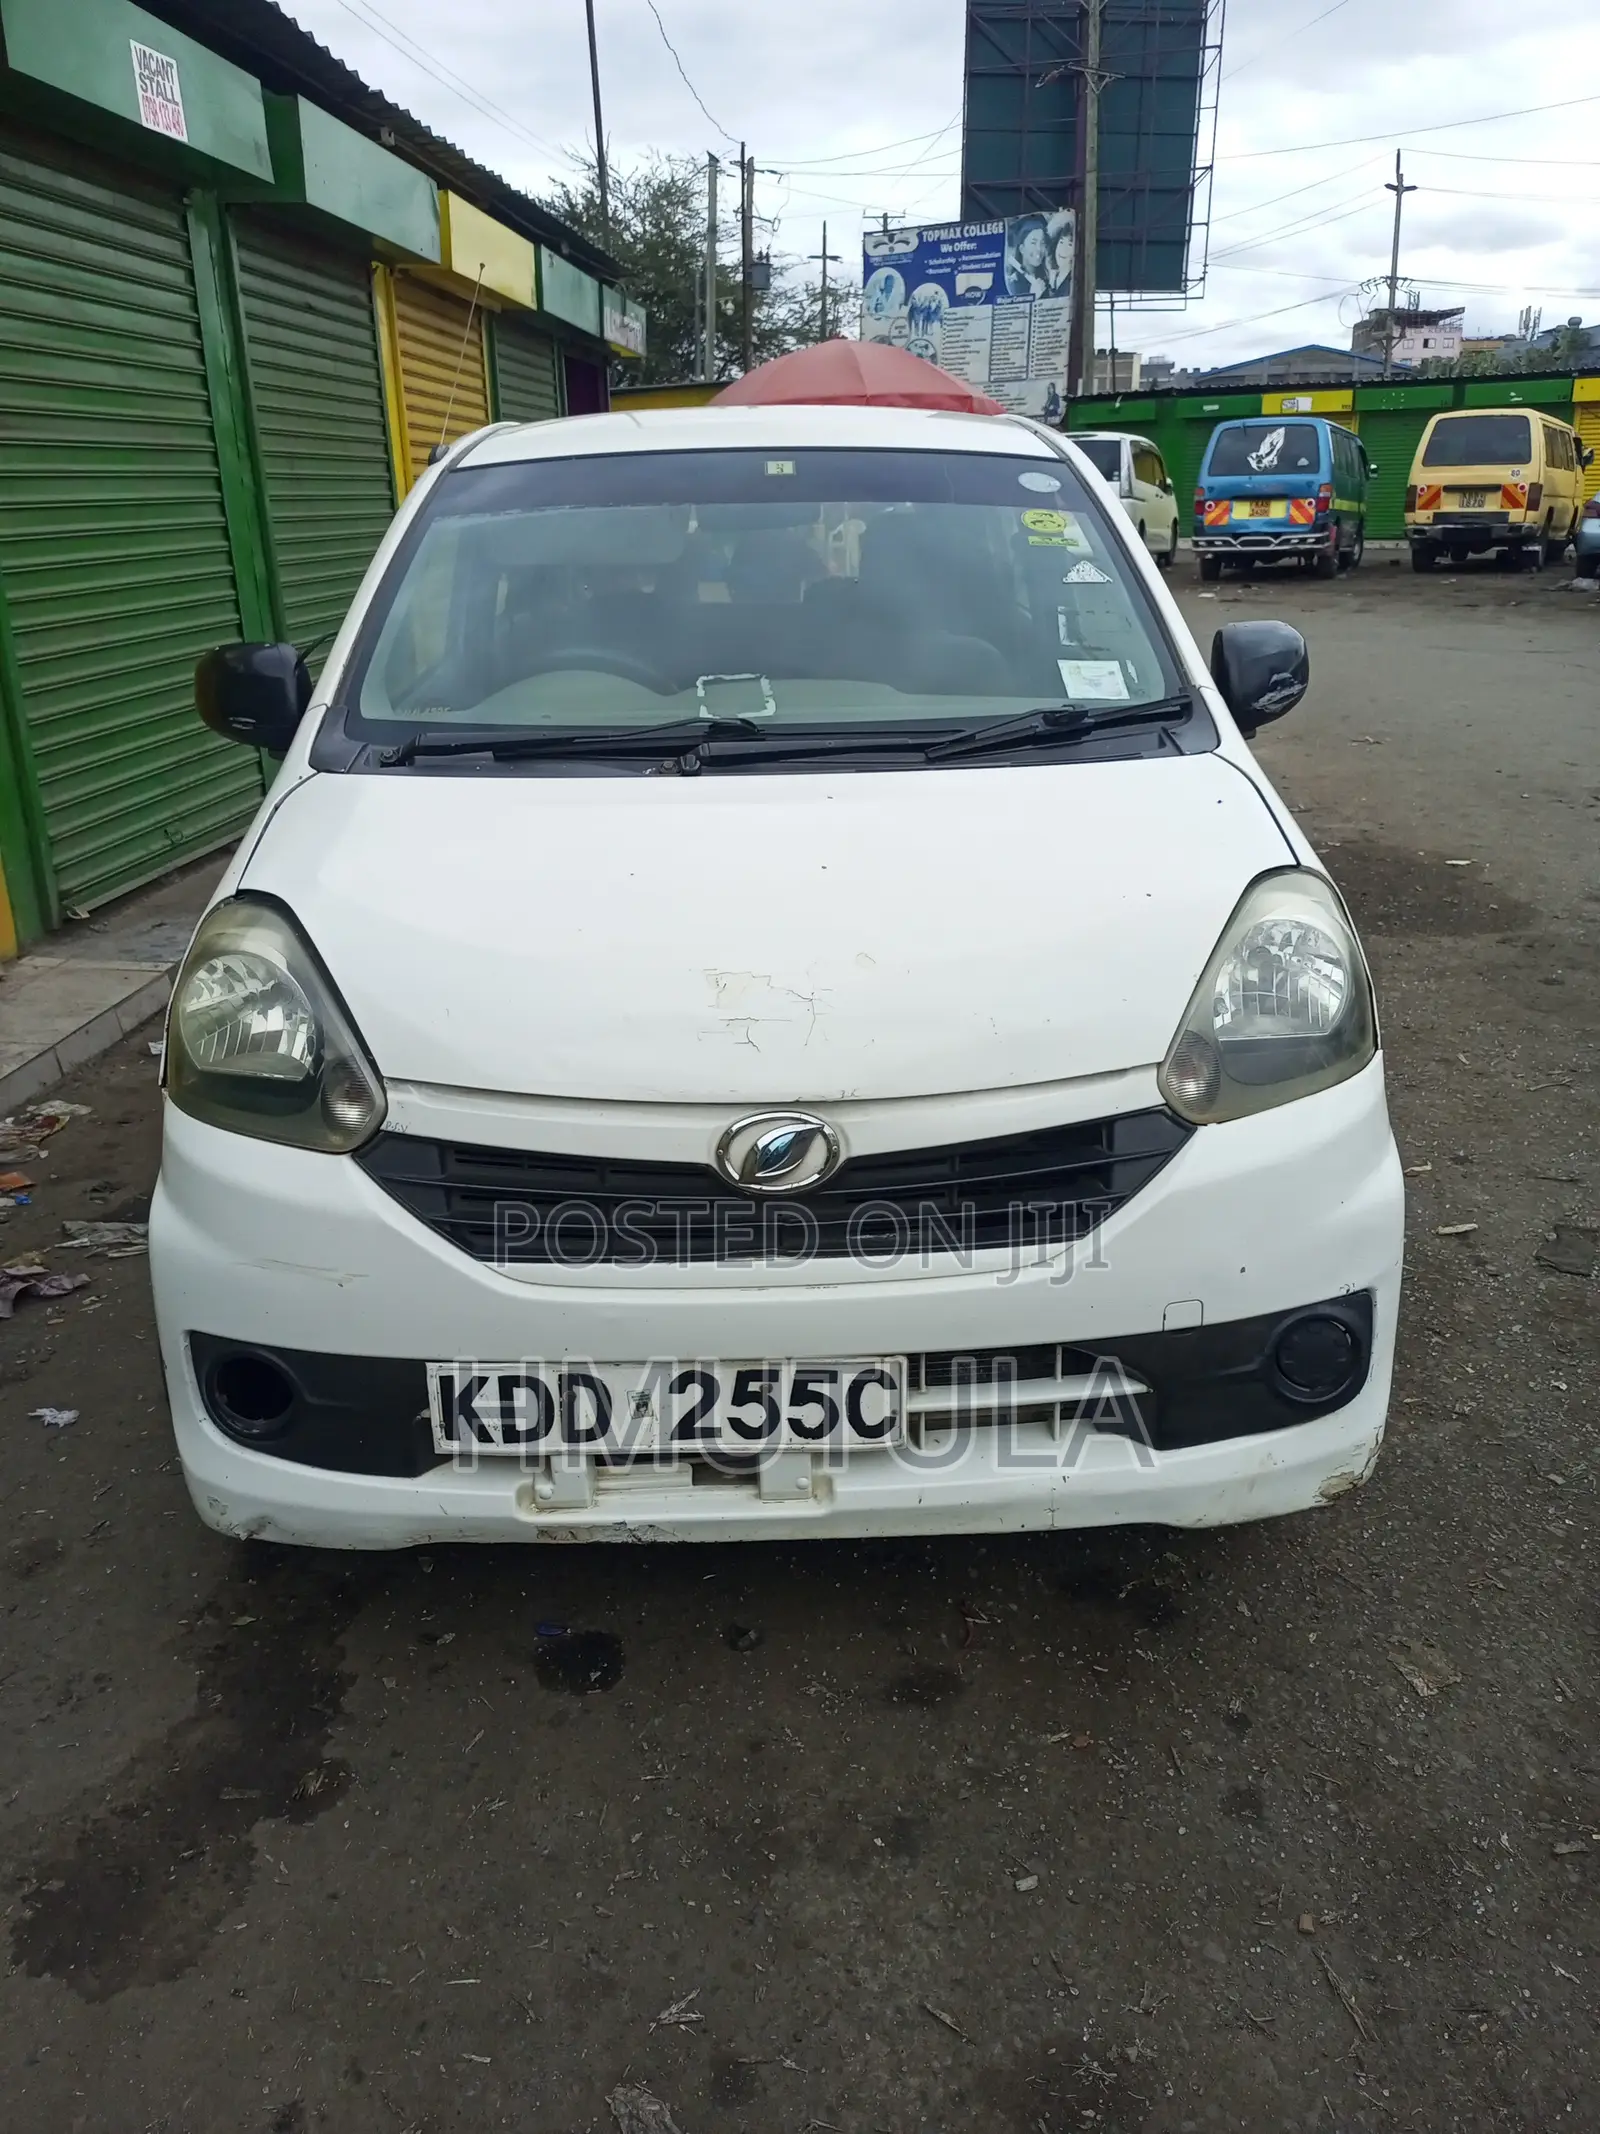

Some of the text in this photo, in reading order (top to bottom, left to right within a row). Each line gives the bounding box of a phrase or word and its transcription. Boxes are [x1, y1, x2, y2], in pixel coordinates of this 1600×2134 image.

[134, 45, 175, 86] VACANT
[138, 71, 180, 107] STALL
[922, 221, 1004, 243] TOPMAX COLLEGE
[940, 243, 954, 254] We
[438, 1368, 899, 1446] KDD 255C
